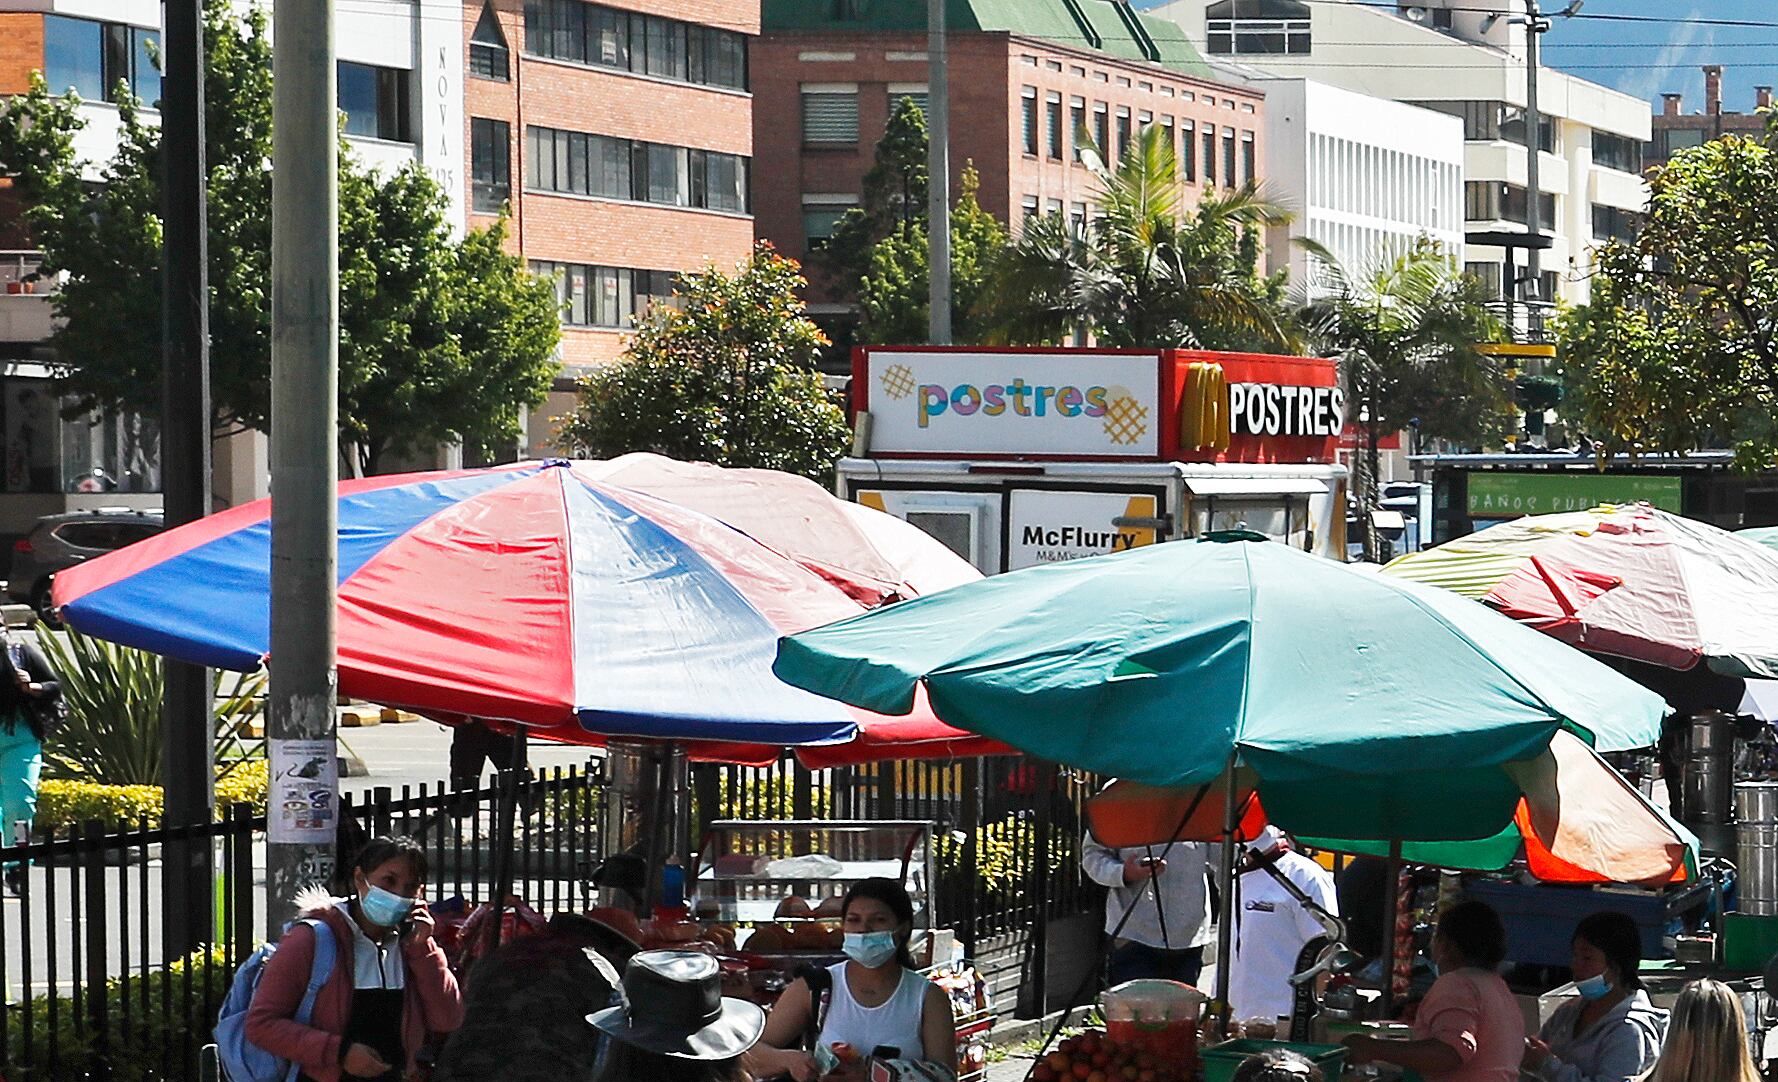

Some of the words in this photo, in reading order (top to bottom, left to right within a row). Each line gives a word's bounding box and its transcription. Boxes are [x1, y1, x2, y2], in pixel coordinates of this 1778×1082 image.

[438, 47, 448, 156] NOVA
[918, 378, 1109, 428] postres
[1230, 383, 1344, 437] POSTRES
[1022, 526, 1136, 550] McFlurry
